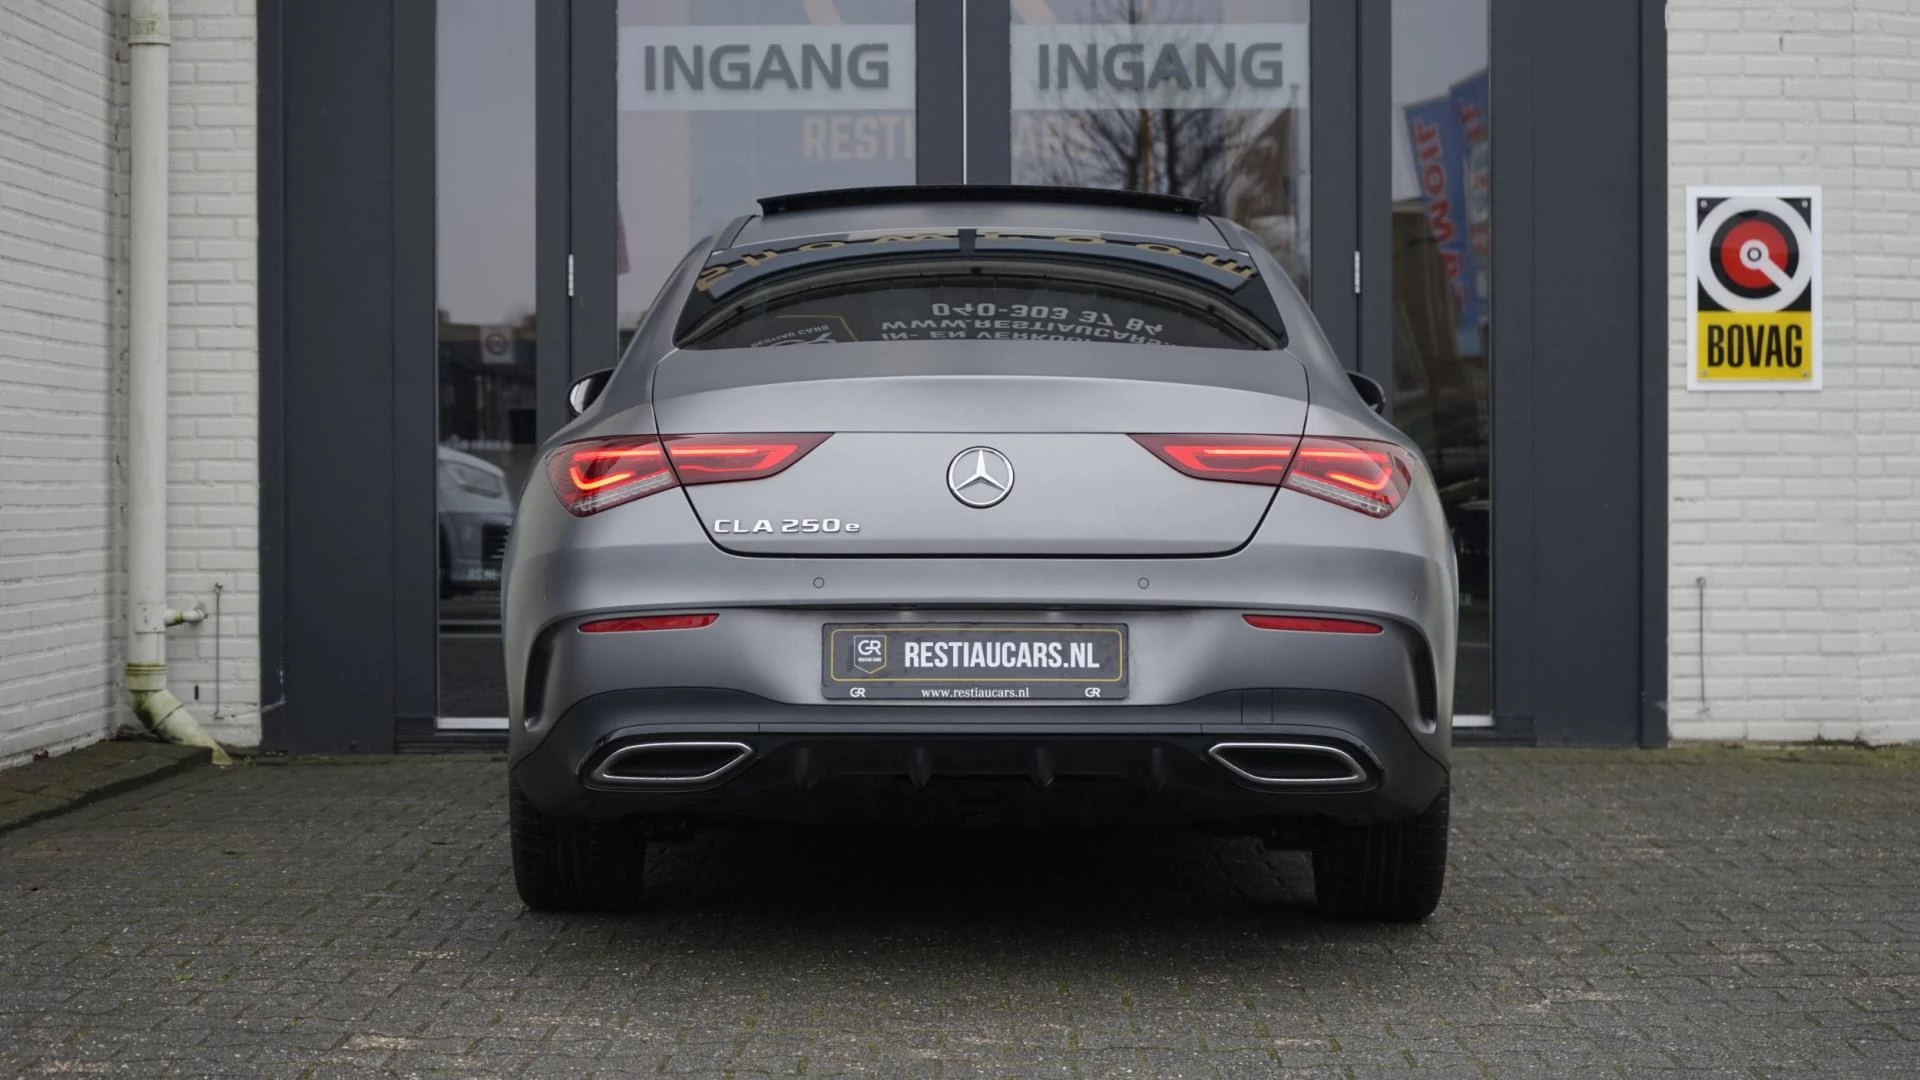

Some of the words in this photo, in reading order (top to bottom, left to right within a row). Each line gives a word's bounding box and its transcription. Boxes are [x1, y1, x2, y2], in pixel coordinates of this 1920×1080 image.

[644, 43, 889, 91] INGANG
[1039, 42, 1283, 90] INGANG
[1707, 324, 1803, 369] BOVAG
[713, 519, 774, 534] CLA
[781, 518, 860, 534] 250e
[904, 641, 1100, 669] RESTIAUCARS.NL
[921, 687, 1030, 698] www.restiaucars.nl
